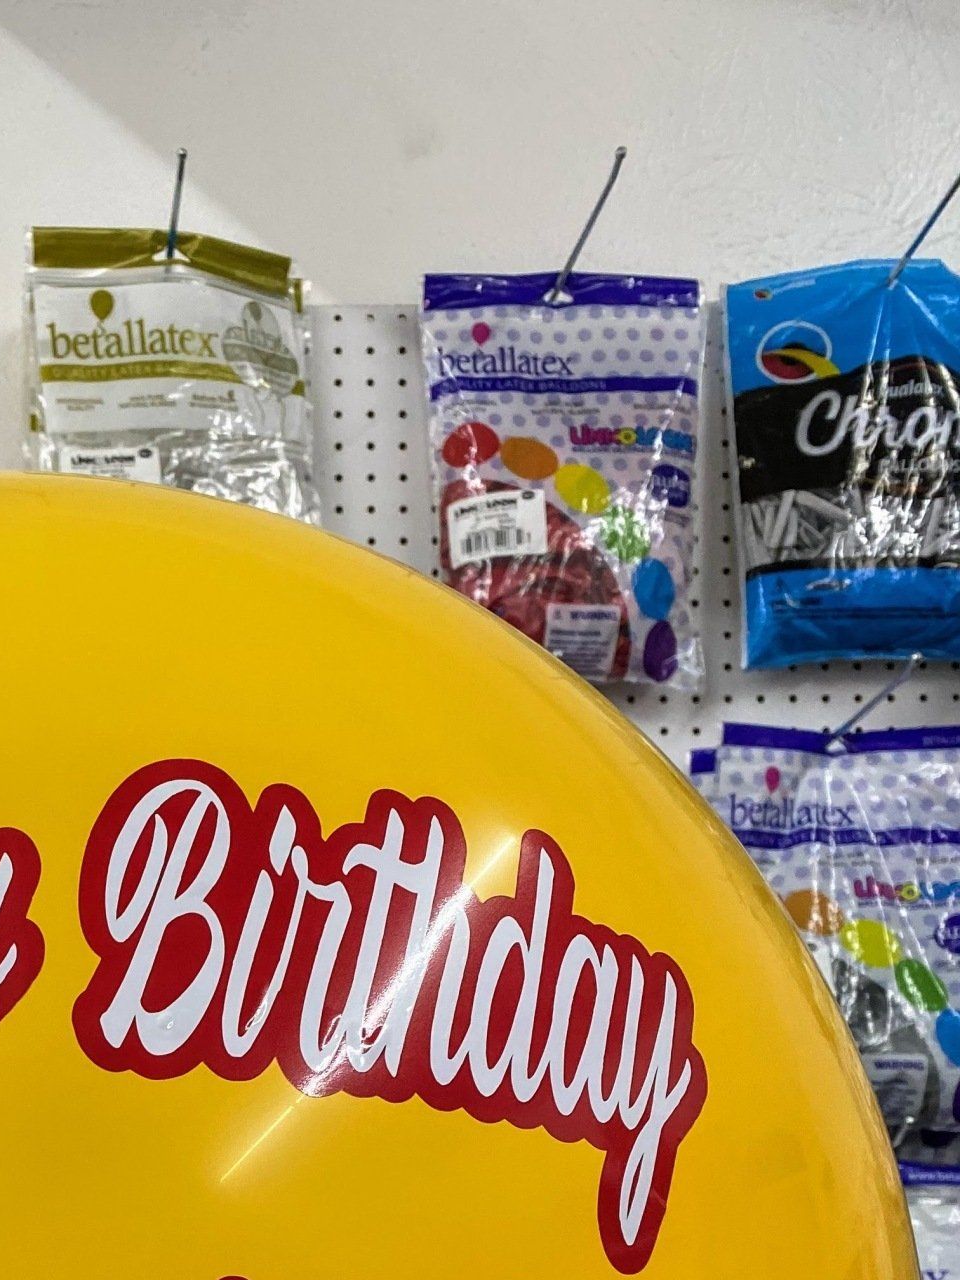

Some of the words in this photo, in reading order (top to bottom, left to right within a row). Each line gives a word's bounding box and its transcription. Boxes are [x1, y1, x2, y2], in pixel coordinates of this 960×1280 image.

[46, 318, 219, 360] betallatex
[437, 345, 574, 377] betallatex
[729, 792, 856, 828] betallatex
[100, 778, 693, 1246] Birthday
[874, 1060, 925, 1072] WARNING
